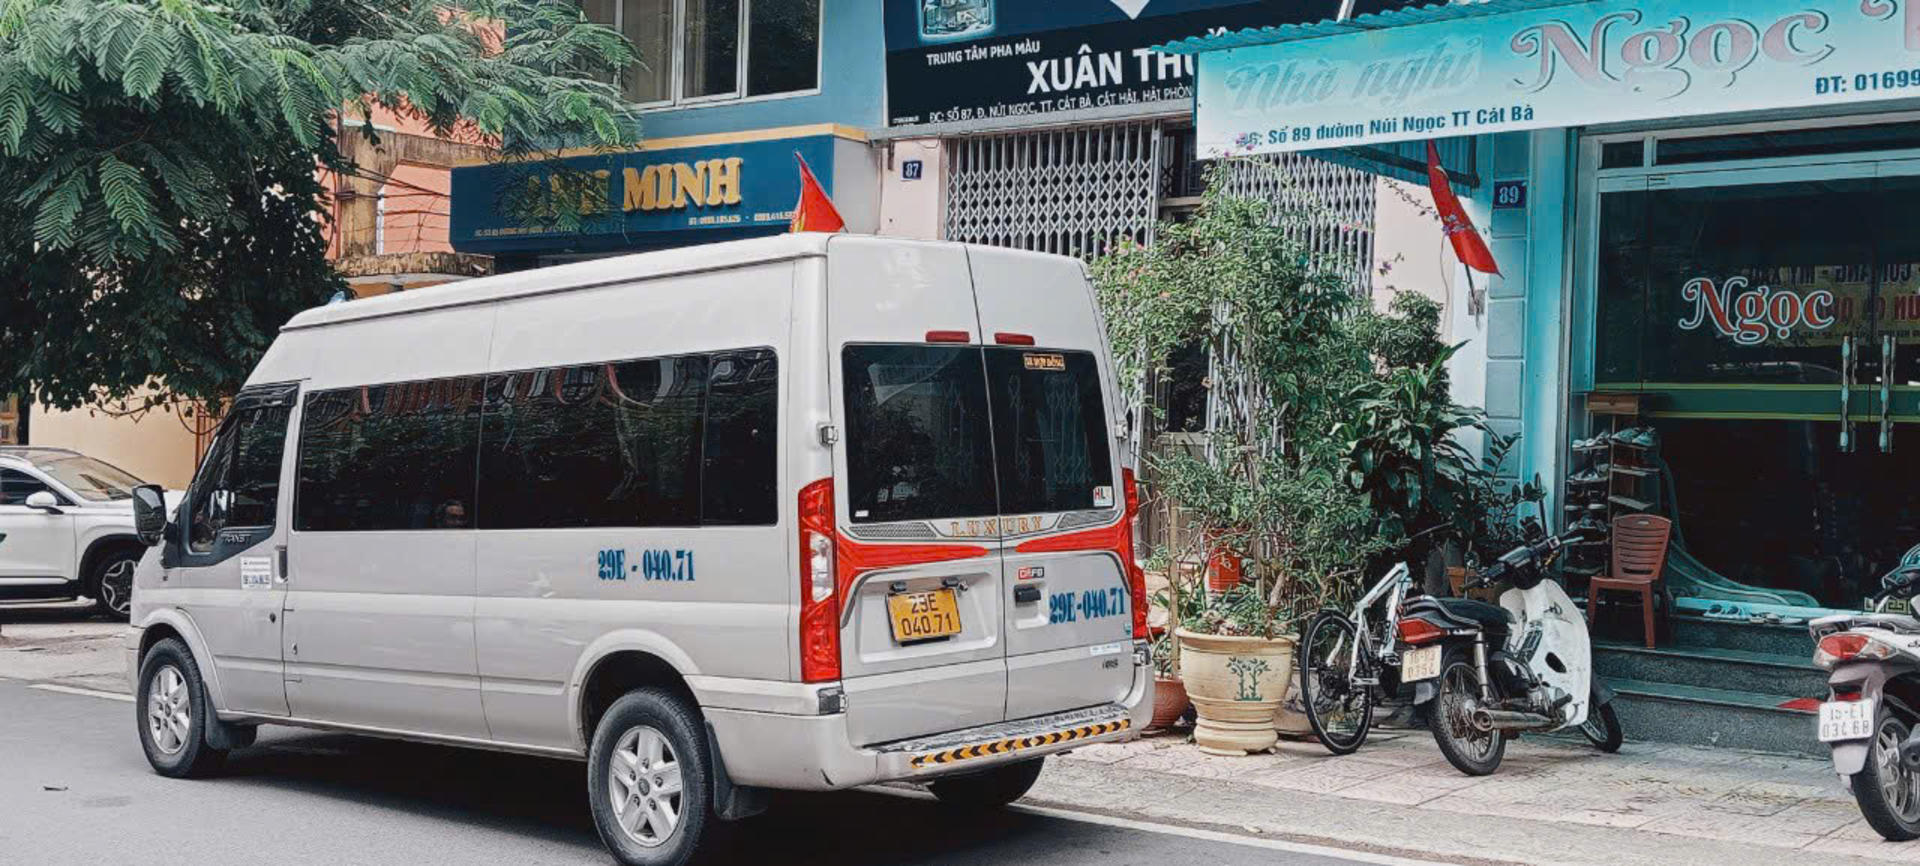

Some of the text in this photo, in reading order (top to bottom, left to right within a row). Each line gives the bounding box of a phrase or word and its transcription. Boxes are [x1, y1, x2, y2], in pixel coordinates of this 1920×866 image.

[926, 38, 1040, 66] TRUNG TÂM PHA MÀU
[1026, 43, 1123, 94] XUÂN
[1507, 9, 1835, 100] Ngọc
[1226, 57, 1340, 112] Nhà
[1816, 69, 1920, 95] ĐT: 01699
[1268, 126, 1287, 144] Số
[1292, 127, 1311, 141] 89
[1370, 118, 1397, 135] Núi
[1403, 115, 1445, 133] Ngọc
[1452, 110, 1470, 127] TT
[1476, 107, 1505, 124] Cát
[1511, 104, 1533, 120] Bà
[623, 157, 743, 212] MINH
[905, 163, 919, 177] 87
[1499, 185, 1518, 204] 89
[1678, 276, 1835, 345] Ngọc
[598, 549, 625, 581] 29E
[643, 549, 695, 581] 040.71
[901, 612, 952, 636] 040.71
